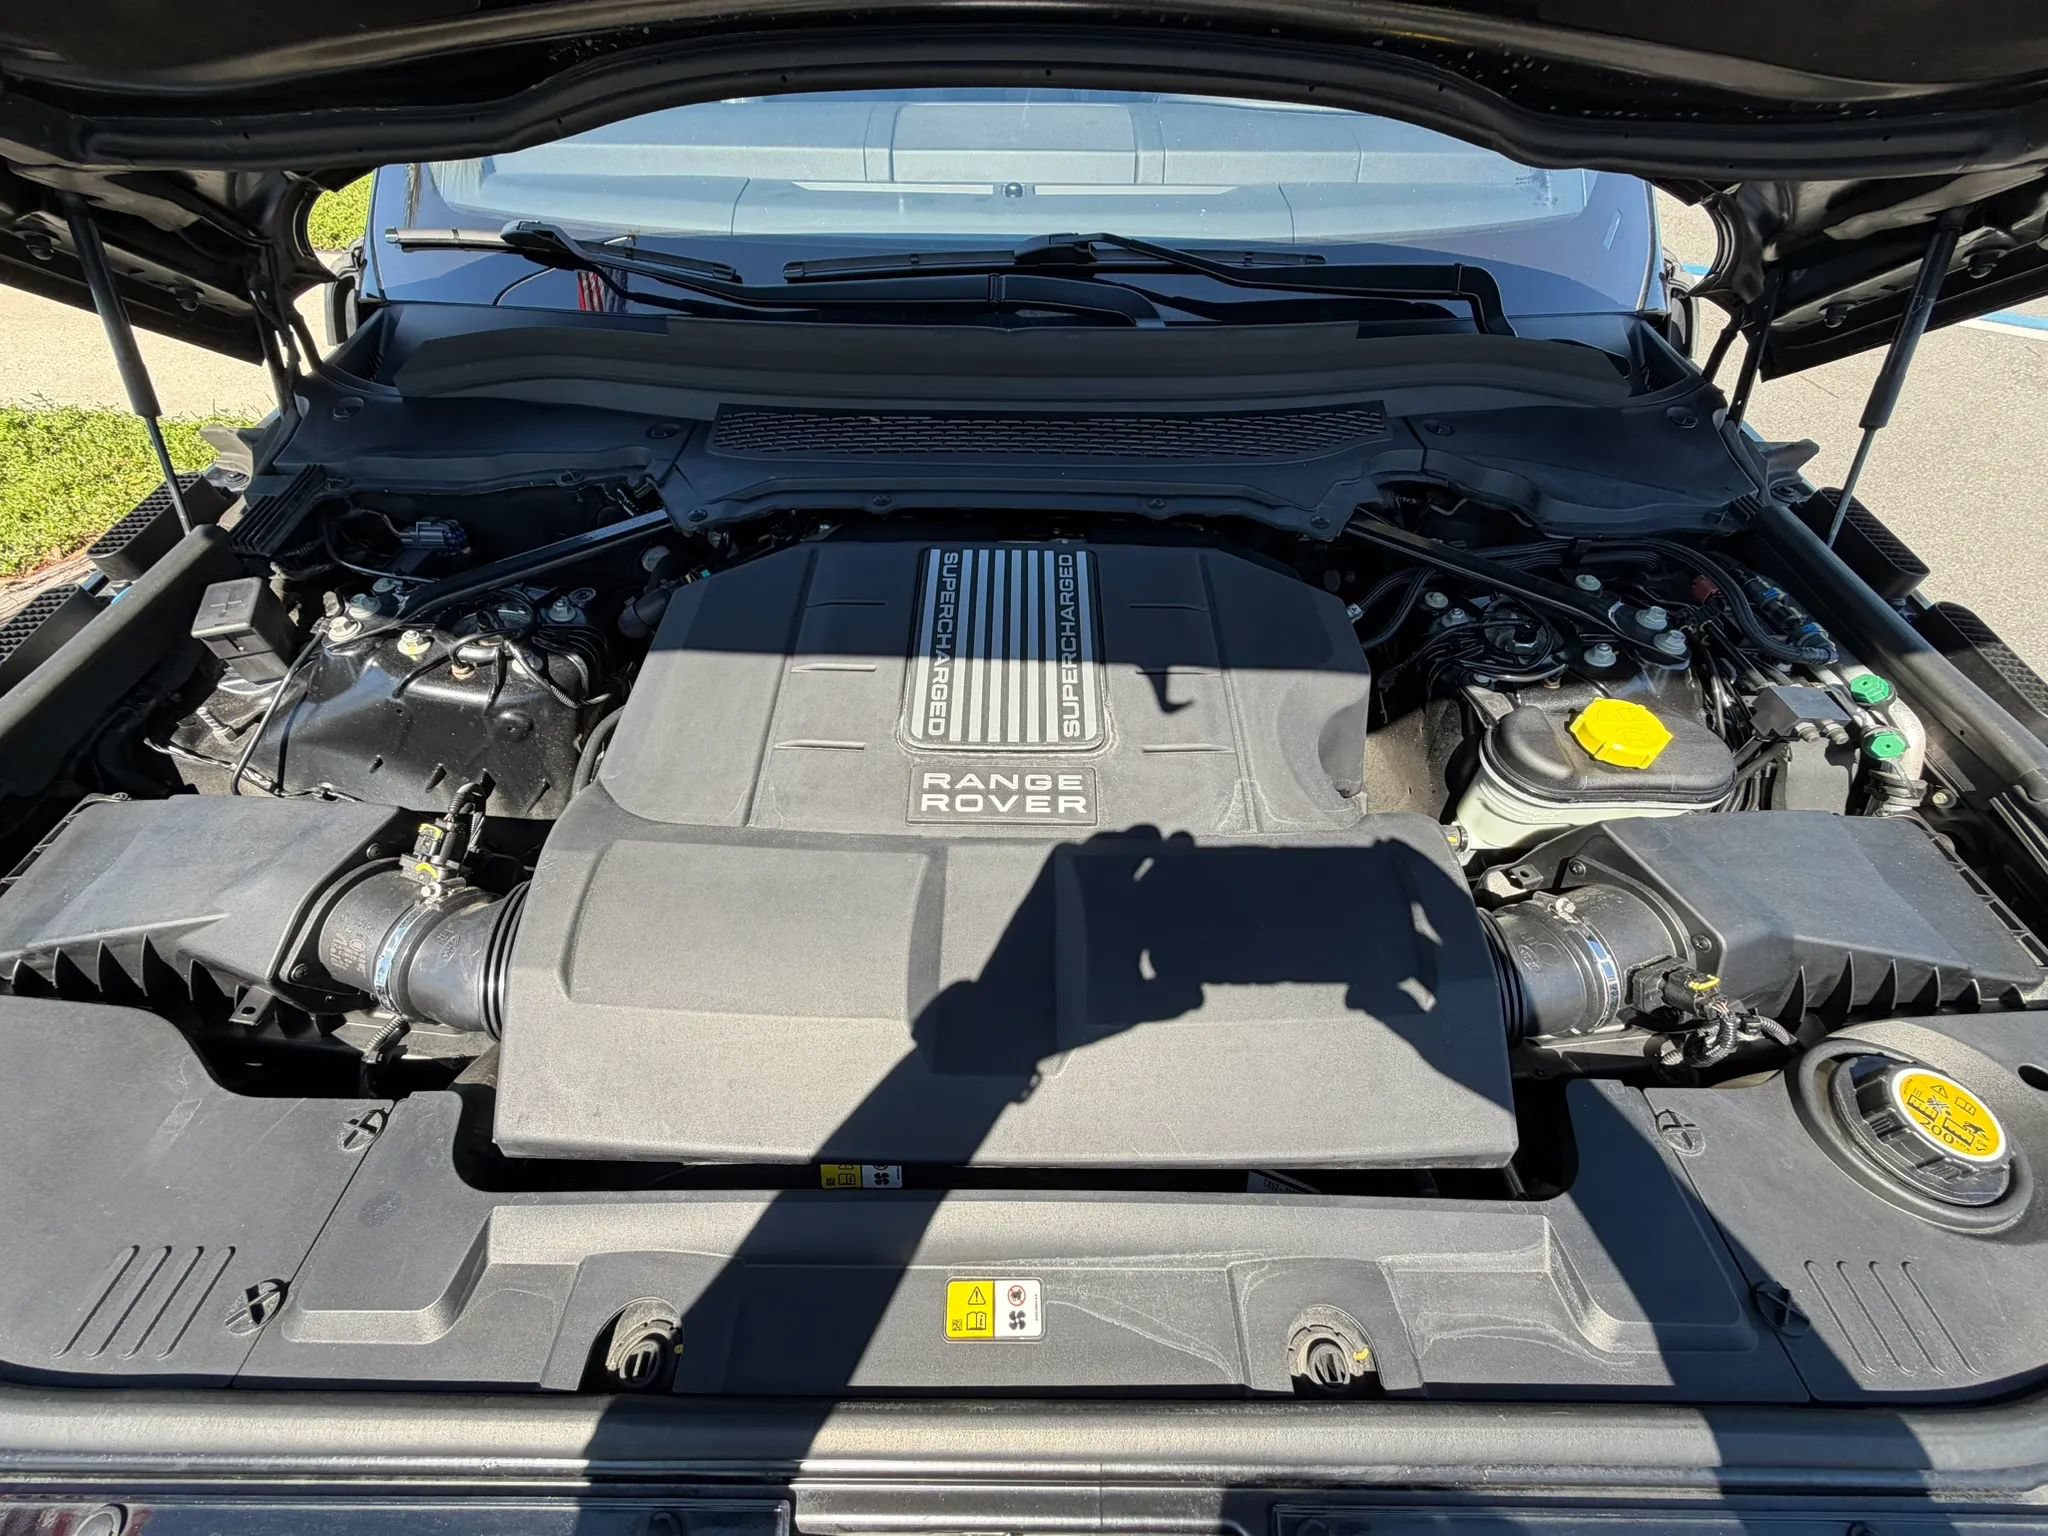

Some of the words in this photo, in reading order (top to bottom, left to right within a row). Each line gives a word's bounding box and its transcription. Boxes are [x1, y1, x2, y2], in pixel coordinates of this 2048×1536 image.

[927, 552, 958, 737] SUPERCHARGED
[1058, 553, 1081, 738] SUPERCHARGED
[920, 793, 1088, 814] ROVER
[922, 772, 1083, 791] RANGE
